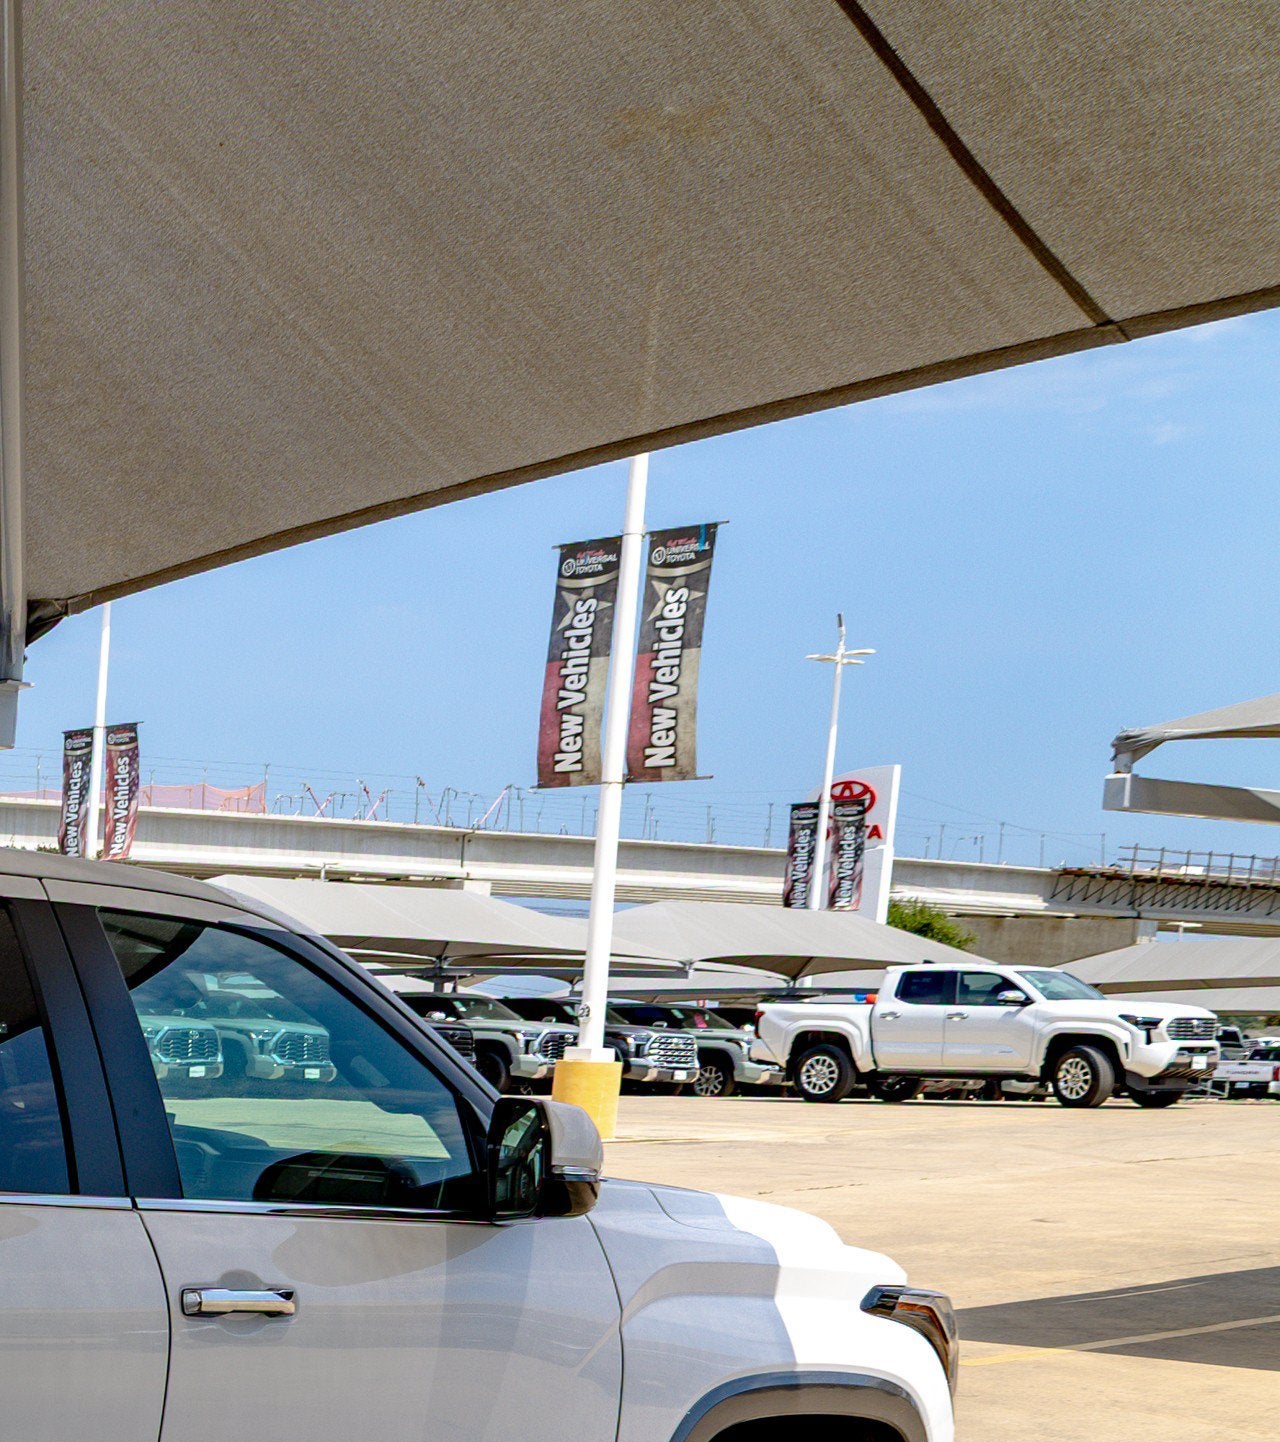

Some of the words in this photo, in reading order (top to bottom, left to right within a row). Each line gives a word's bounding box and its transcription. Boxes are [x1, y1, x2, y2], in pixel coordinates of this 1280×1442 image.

[575, 563, 603, 575] TOYOTA
[666, 552, 696, 563] TOYOTA
[557, 598, 598, 711] Vehicles
[648, 586, 689, 703] Vehicles
[554, 713, 584, 773] New
[644, 707, 677, 768] New
[66, 761, 83, 823] Vehicles
[114, 756, 130, 820] Vehicles
[110, 822, 126, 854] New
[792, 829, 811, 881] Vehicles
[838, 826, 856, 880] Vehicles
[836, 880, 852, 907] New
